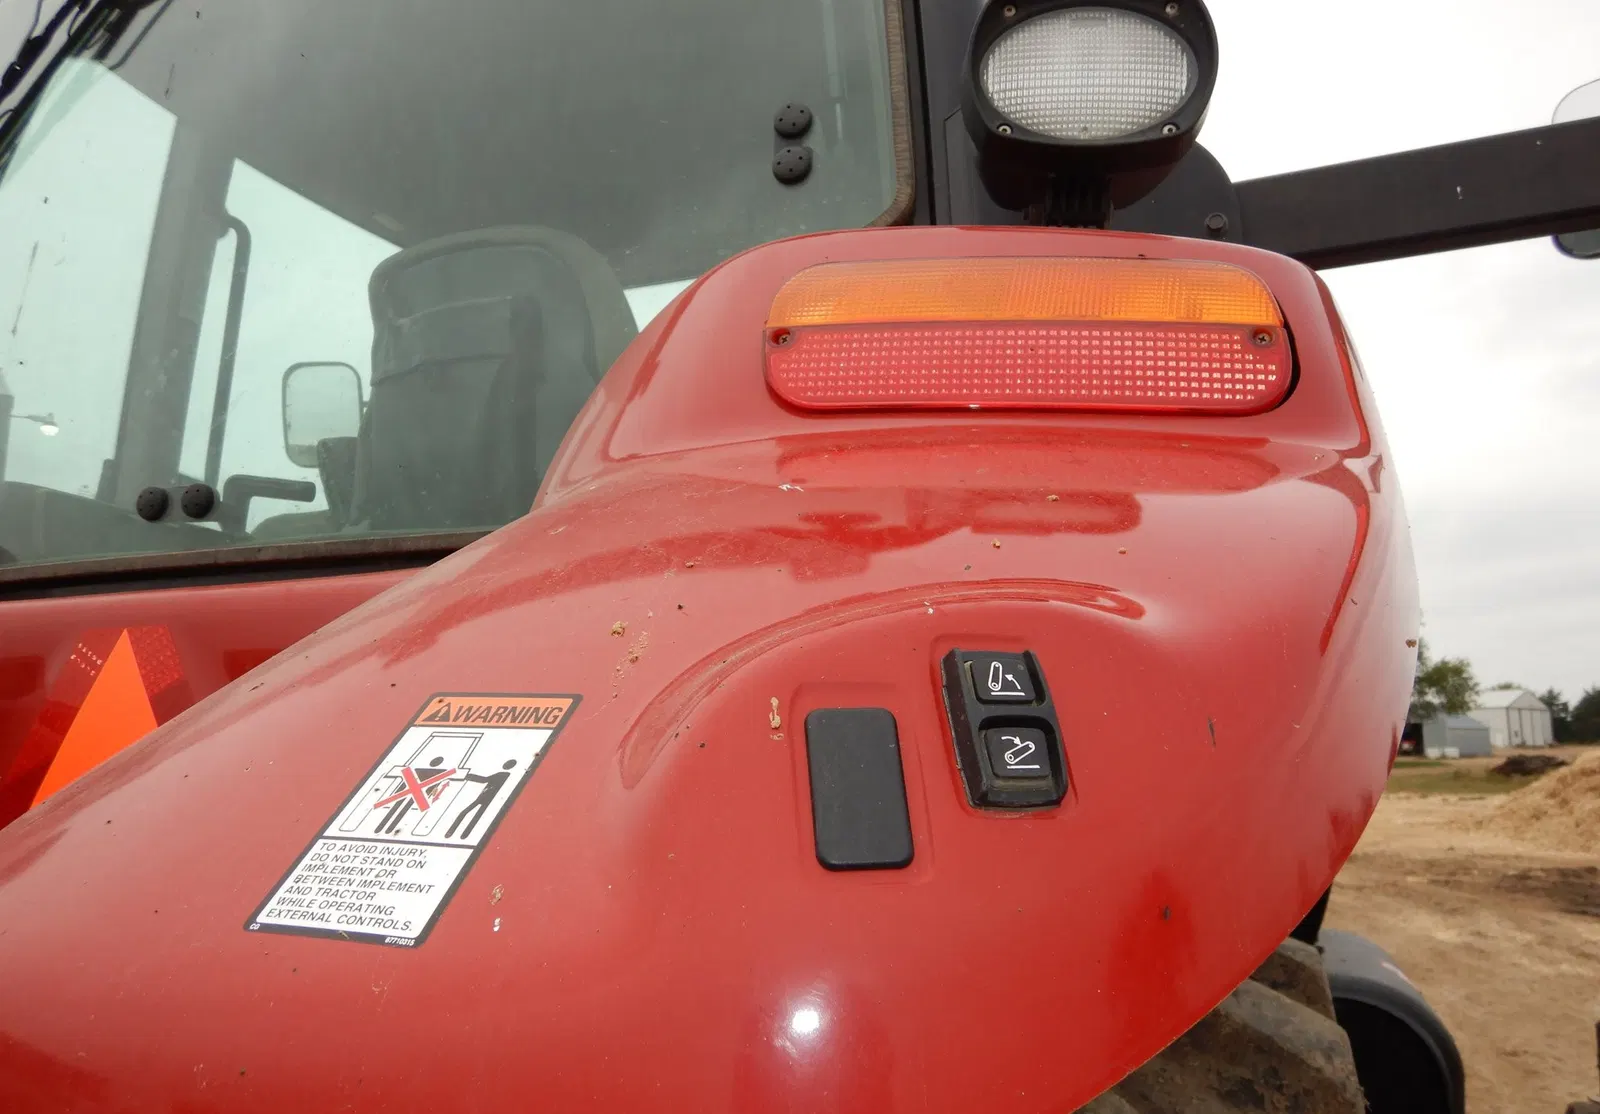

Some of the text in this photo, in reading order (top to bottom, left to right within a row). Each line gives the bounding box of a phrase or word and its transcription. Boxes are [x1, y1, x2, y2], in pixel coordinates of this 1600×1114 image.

[452, 706, 563, 724] WARNING
[320, 843, 336, 851] TO
[338, 844, 377, 854] AVOID
[311, 853, 427, 869] DO NOT STAND ON
[302, 864, 397, 878] IMPLEMENT OR
[293, 875, 434, 894] BETWEEN IMPLEMENT
[284, 886, 377, 901] AND TRACTOR
[276, 897, 395, 916] WHILE OPERATING
[266, 908, 412, 931] EXTERNAL CONTROLS.
